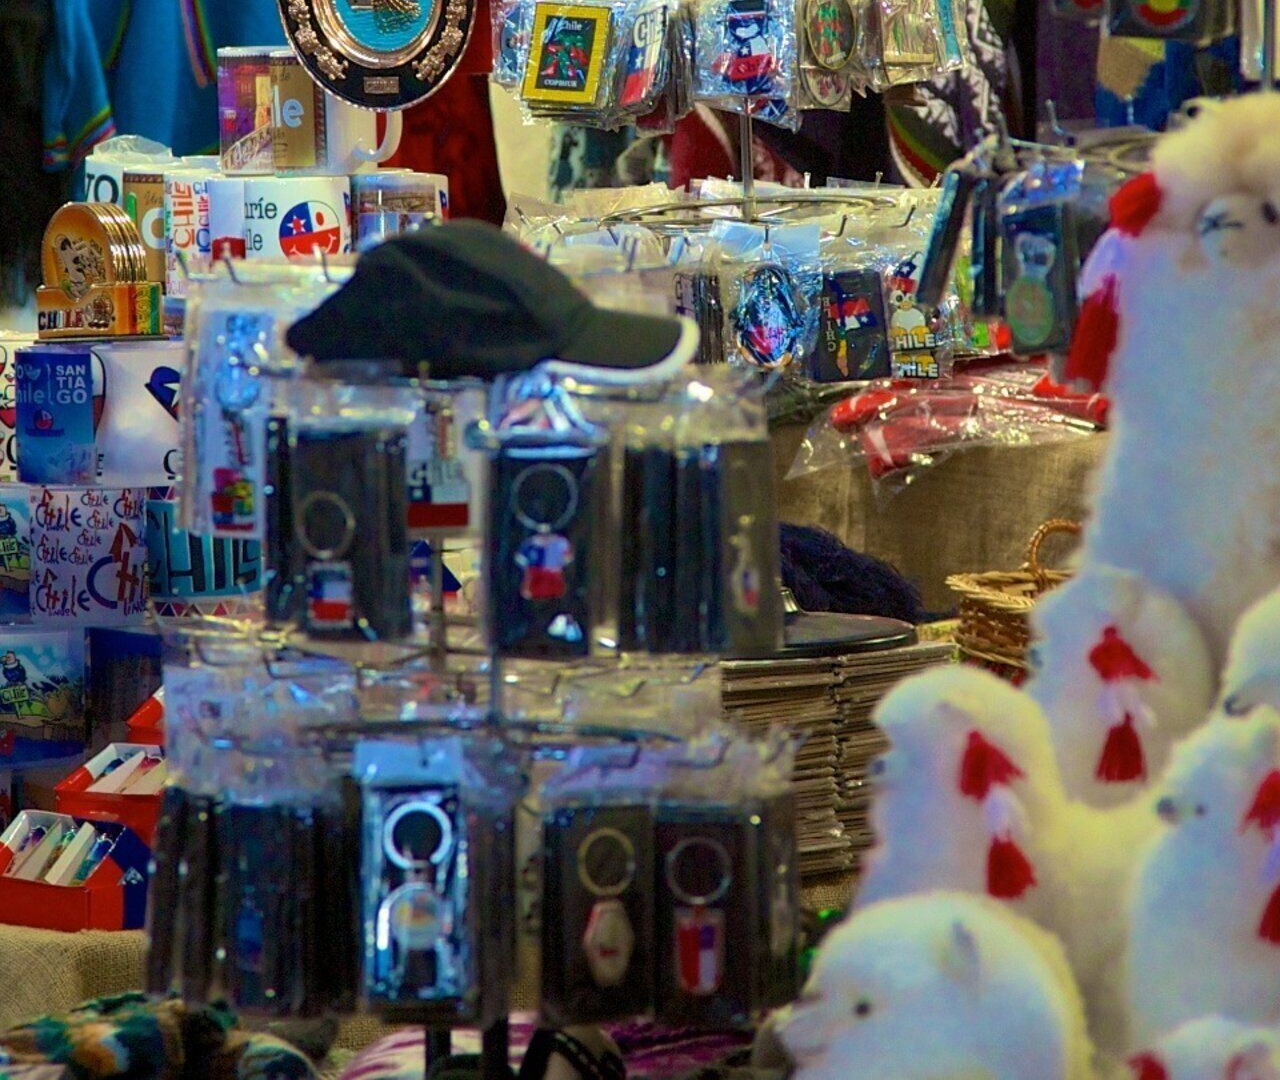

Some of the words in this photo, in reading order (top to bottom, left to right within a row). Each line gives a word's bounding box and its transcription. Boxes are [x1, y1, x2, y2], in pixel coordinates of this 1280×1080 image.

[38, 308, 84, 331] CHILE
[894, 332, 937, 351] HILE
[56, 364, 86, 376] SAN
[56, 376, 86, 389] TIA
[56, 389, 88, 405] GO
